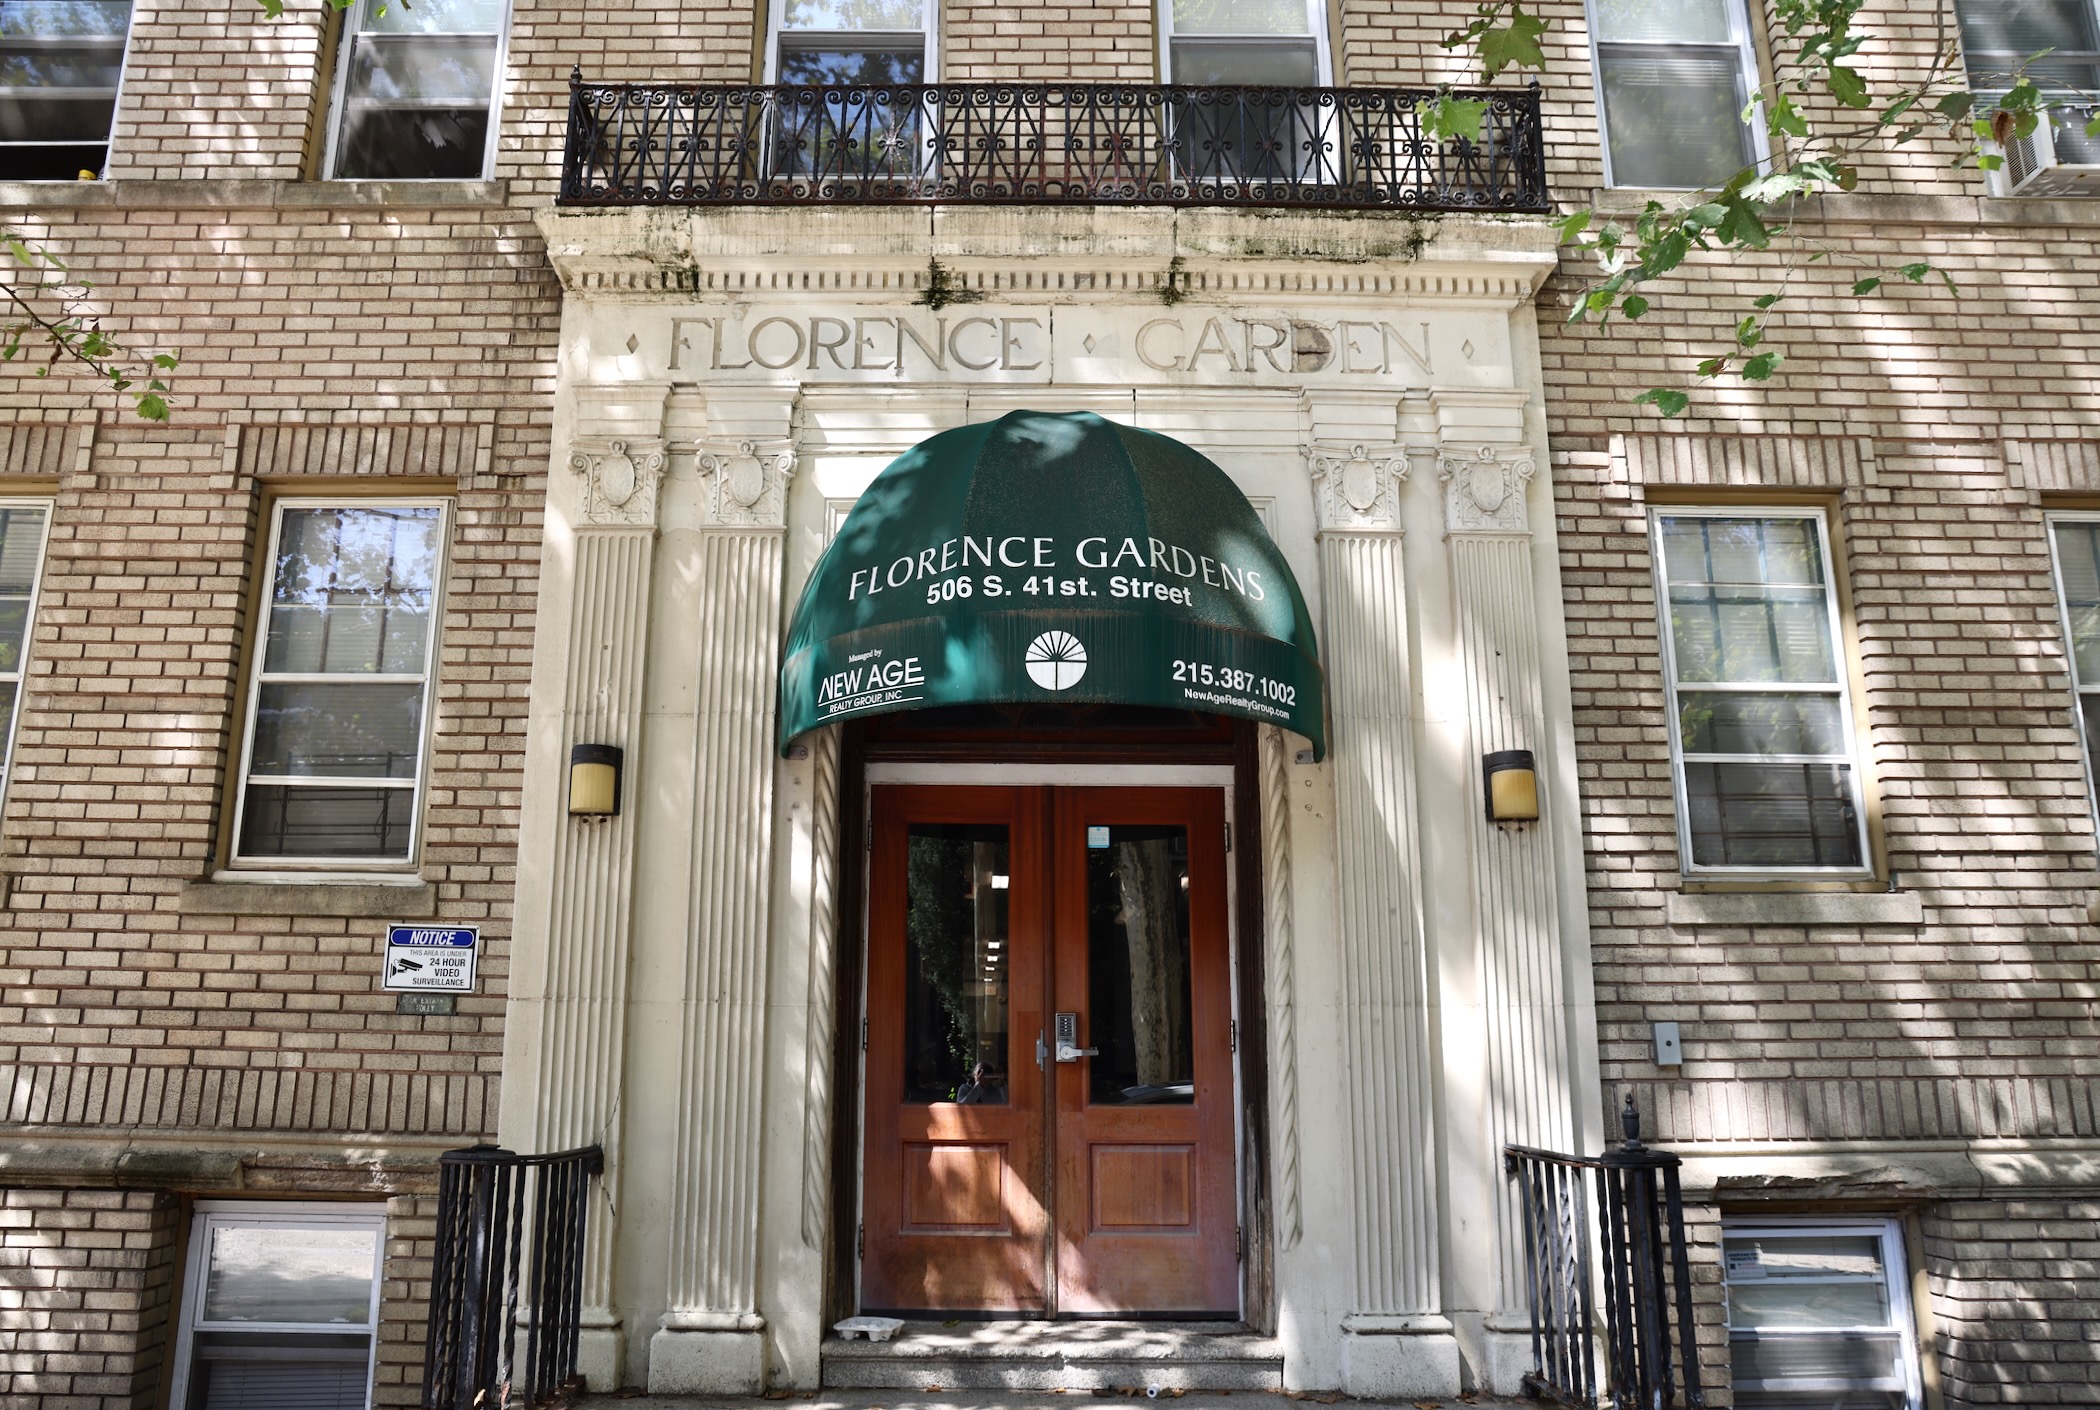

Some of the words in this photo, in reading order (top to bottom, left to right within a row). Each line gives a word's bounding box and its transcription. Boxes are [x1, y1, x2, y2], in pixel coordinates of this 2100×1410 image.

[667, 316, 1044, 371] FLORENCE
[1134, 317, 1434, 375] GARDEN
[848, 535, 1056, 601] FLORENCE
[1075, 537, 1265, 601] GARDENS
[926, 575, 973, 605] 506
[982, 575, 1012, 597] S.
[1022, 575, 1097, 597] 41st.
[1109, 575, 1193, 607] Street
[848, 649, 874, 663] Managed
[873, 648, 882, 658] by
[818, 667, 863, 703] NEW
[866, 657, 925, 690] AGE
[1172, 659, 1296, 707] 215.387.1002
[829, 700, 853, 714] REALTY
[1184, 688, 1290, 719] NewAgeRealtyGroup.com
[409, 930, 457, 945] NOTICE
[429, 958, 441, 967] 24
[442, 958, 466, 967] HOUR
[434, 968, 460, 977] VIDEO
[412, 977, 464, 986] SURVEILLANCE
